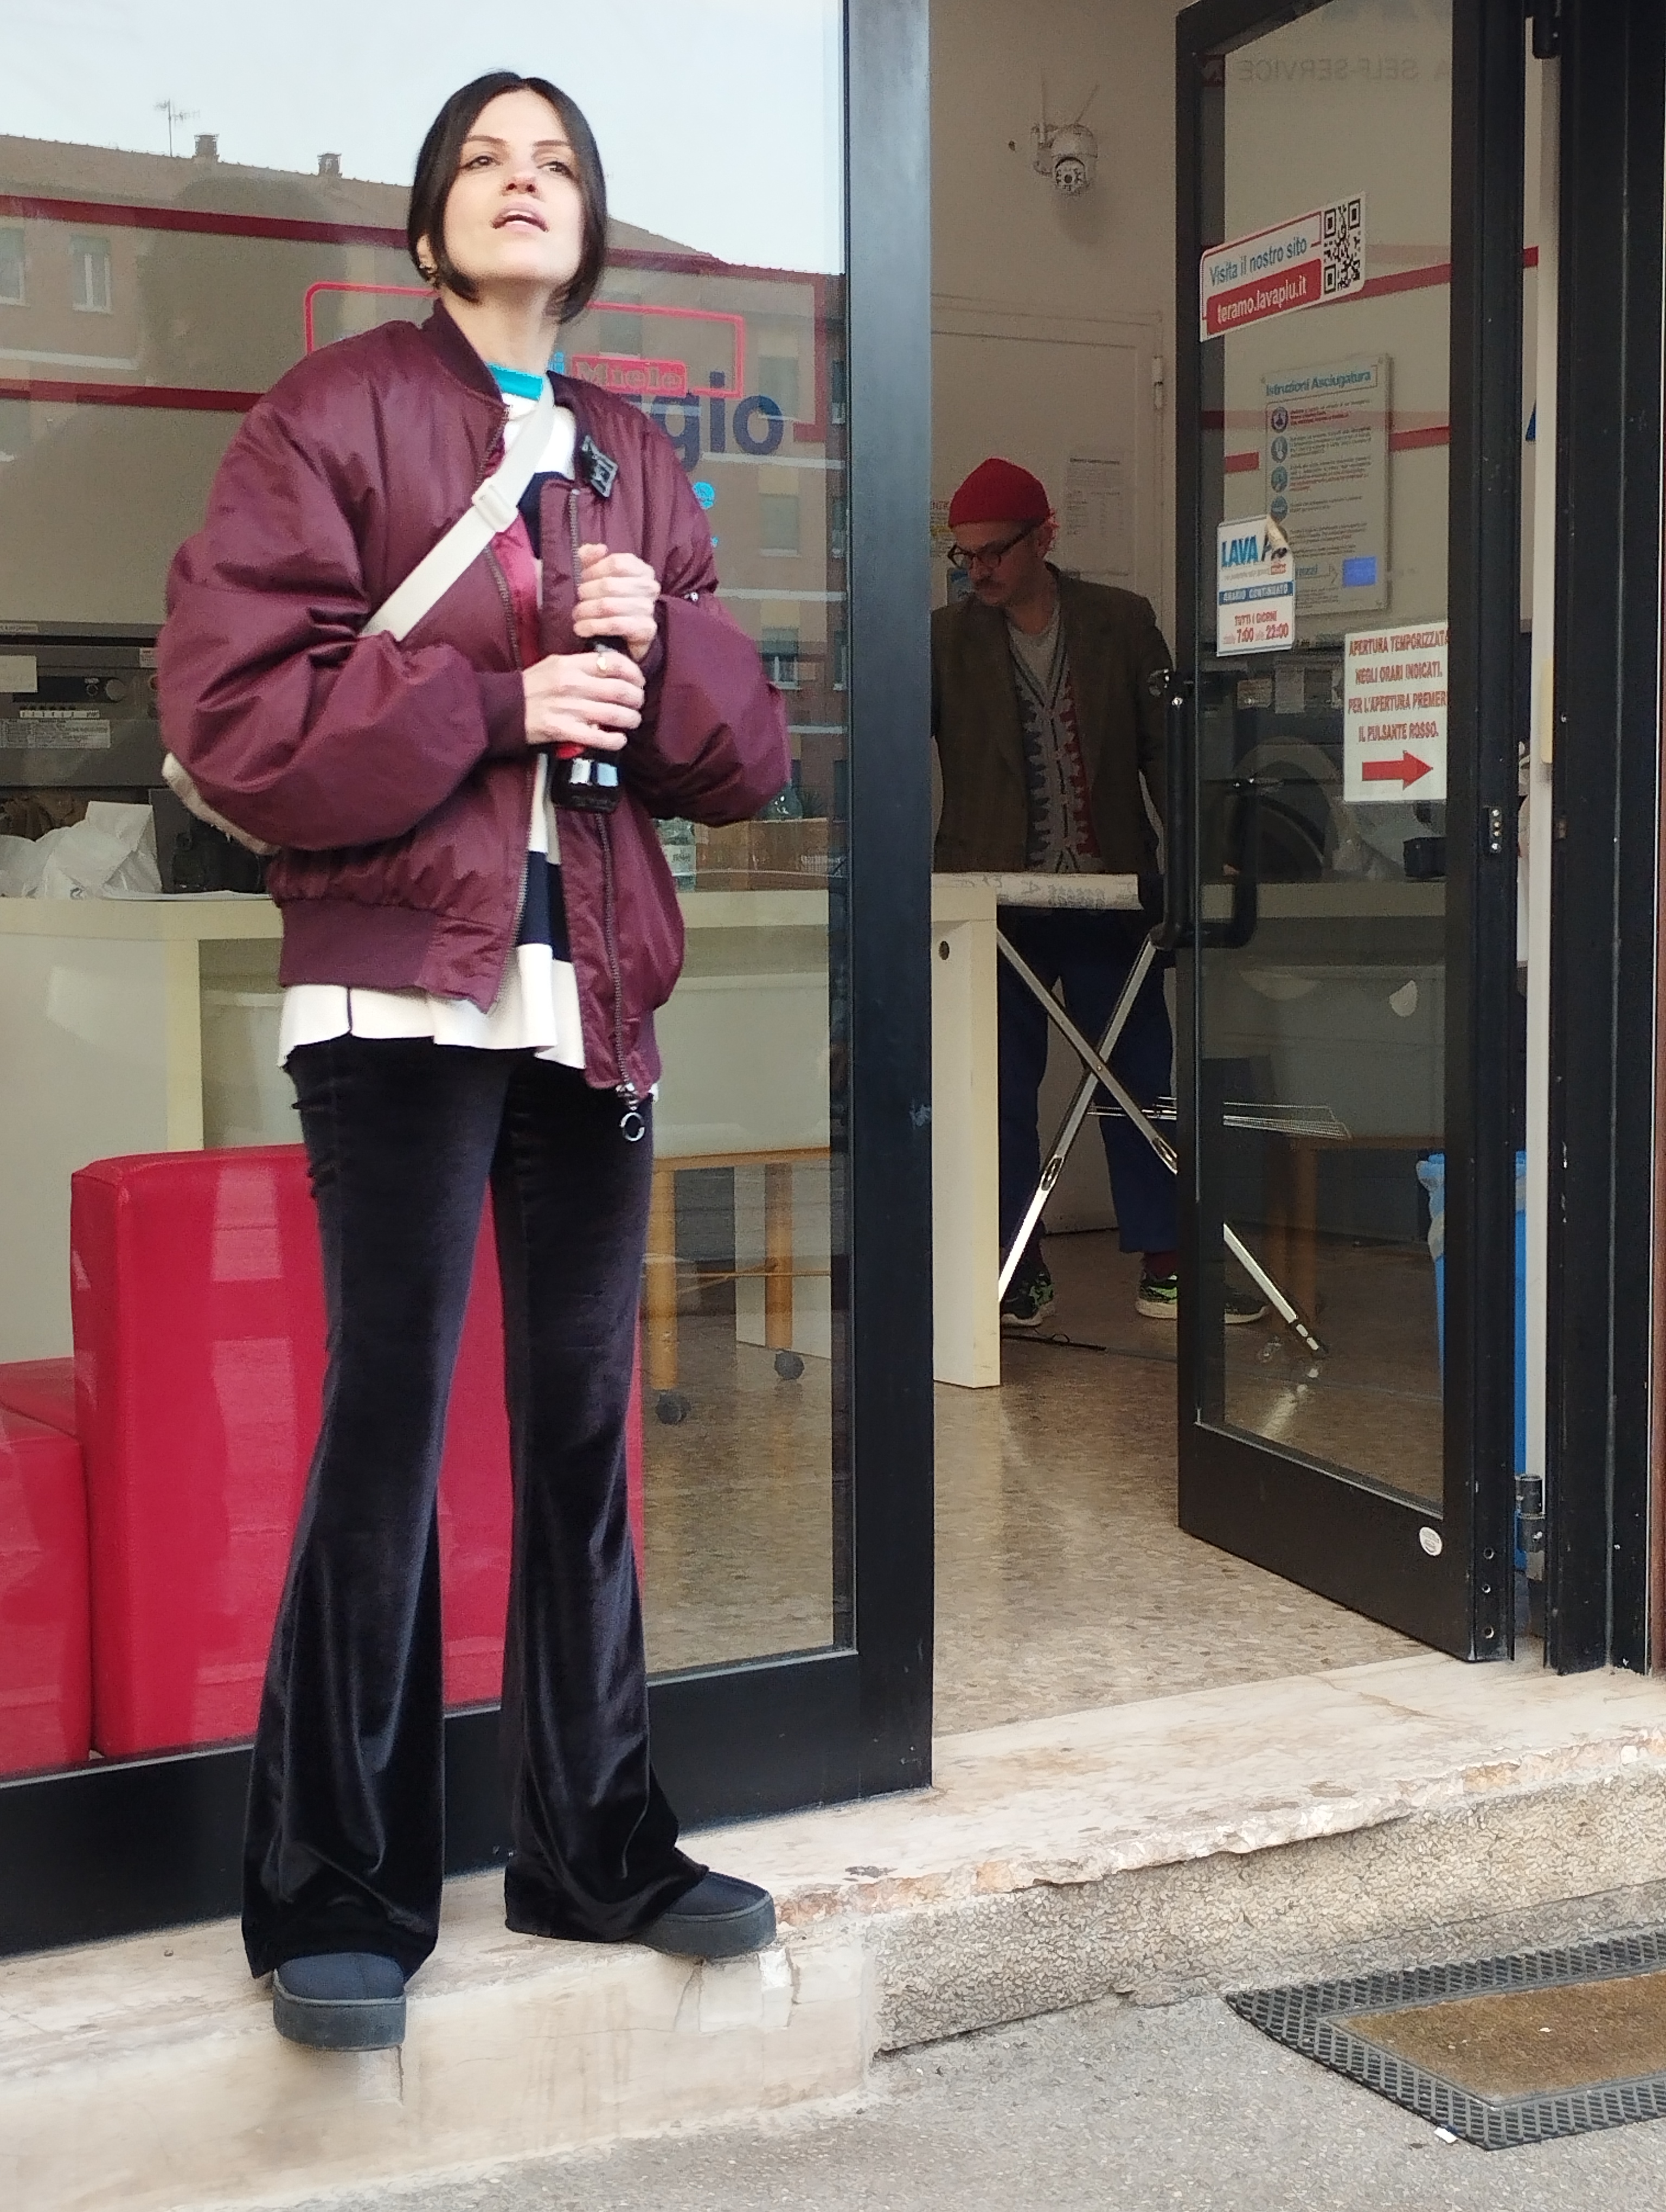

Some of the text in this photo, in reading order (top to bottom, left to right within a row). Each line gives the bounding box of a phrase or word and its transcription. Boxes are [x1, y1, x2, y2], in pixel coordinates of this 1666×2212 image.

[1209, 236, 1308, 286] Visita il nostro sito
[576, 362, 683, 388] Miele
[1266, 371, 1372, 396] Istruzioni Asciugatura
[624, 370, 784, 472] gio
[1221, 535, 1259, 568] LAVA
[1236, 627, 1254, 643] 7:00
[1349, 637, 1388, 657] APERTURA
[1356, 666, 1377, 685] NEGLI
[1380, 664, 1403, 683] ORARI
[1348, 691, 1447, 715] PER L'APERTURA PREMER
[1359, 726, 1366, 742] IL
[1368, 723, 1407, 742] PULSANTE
